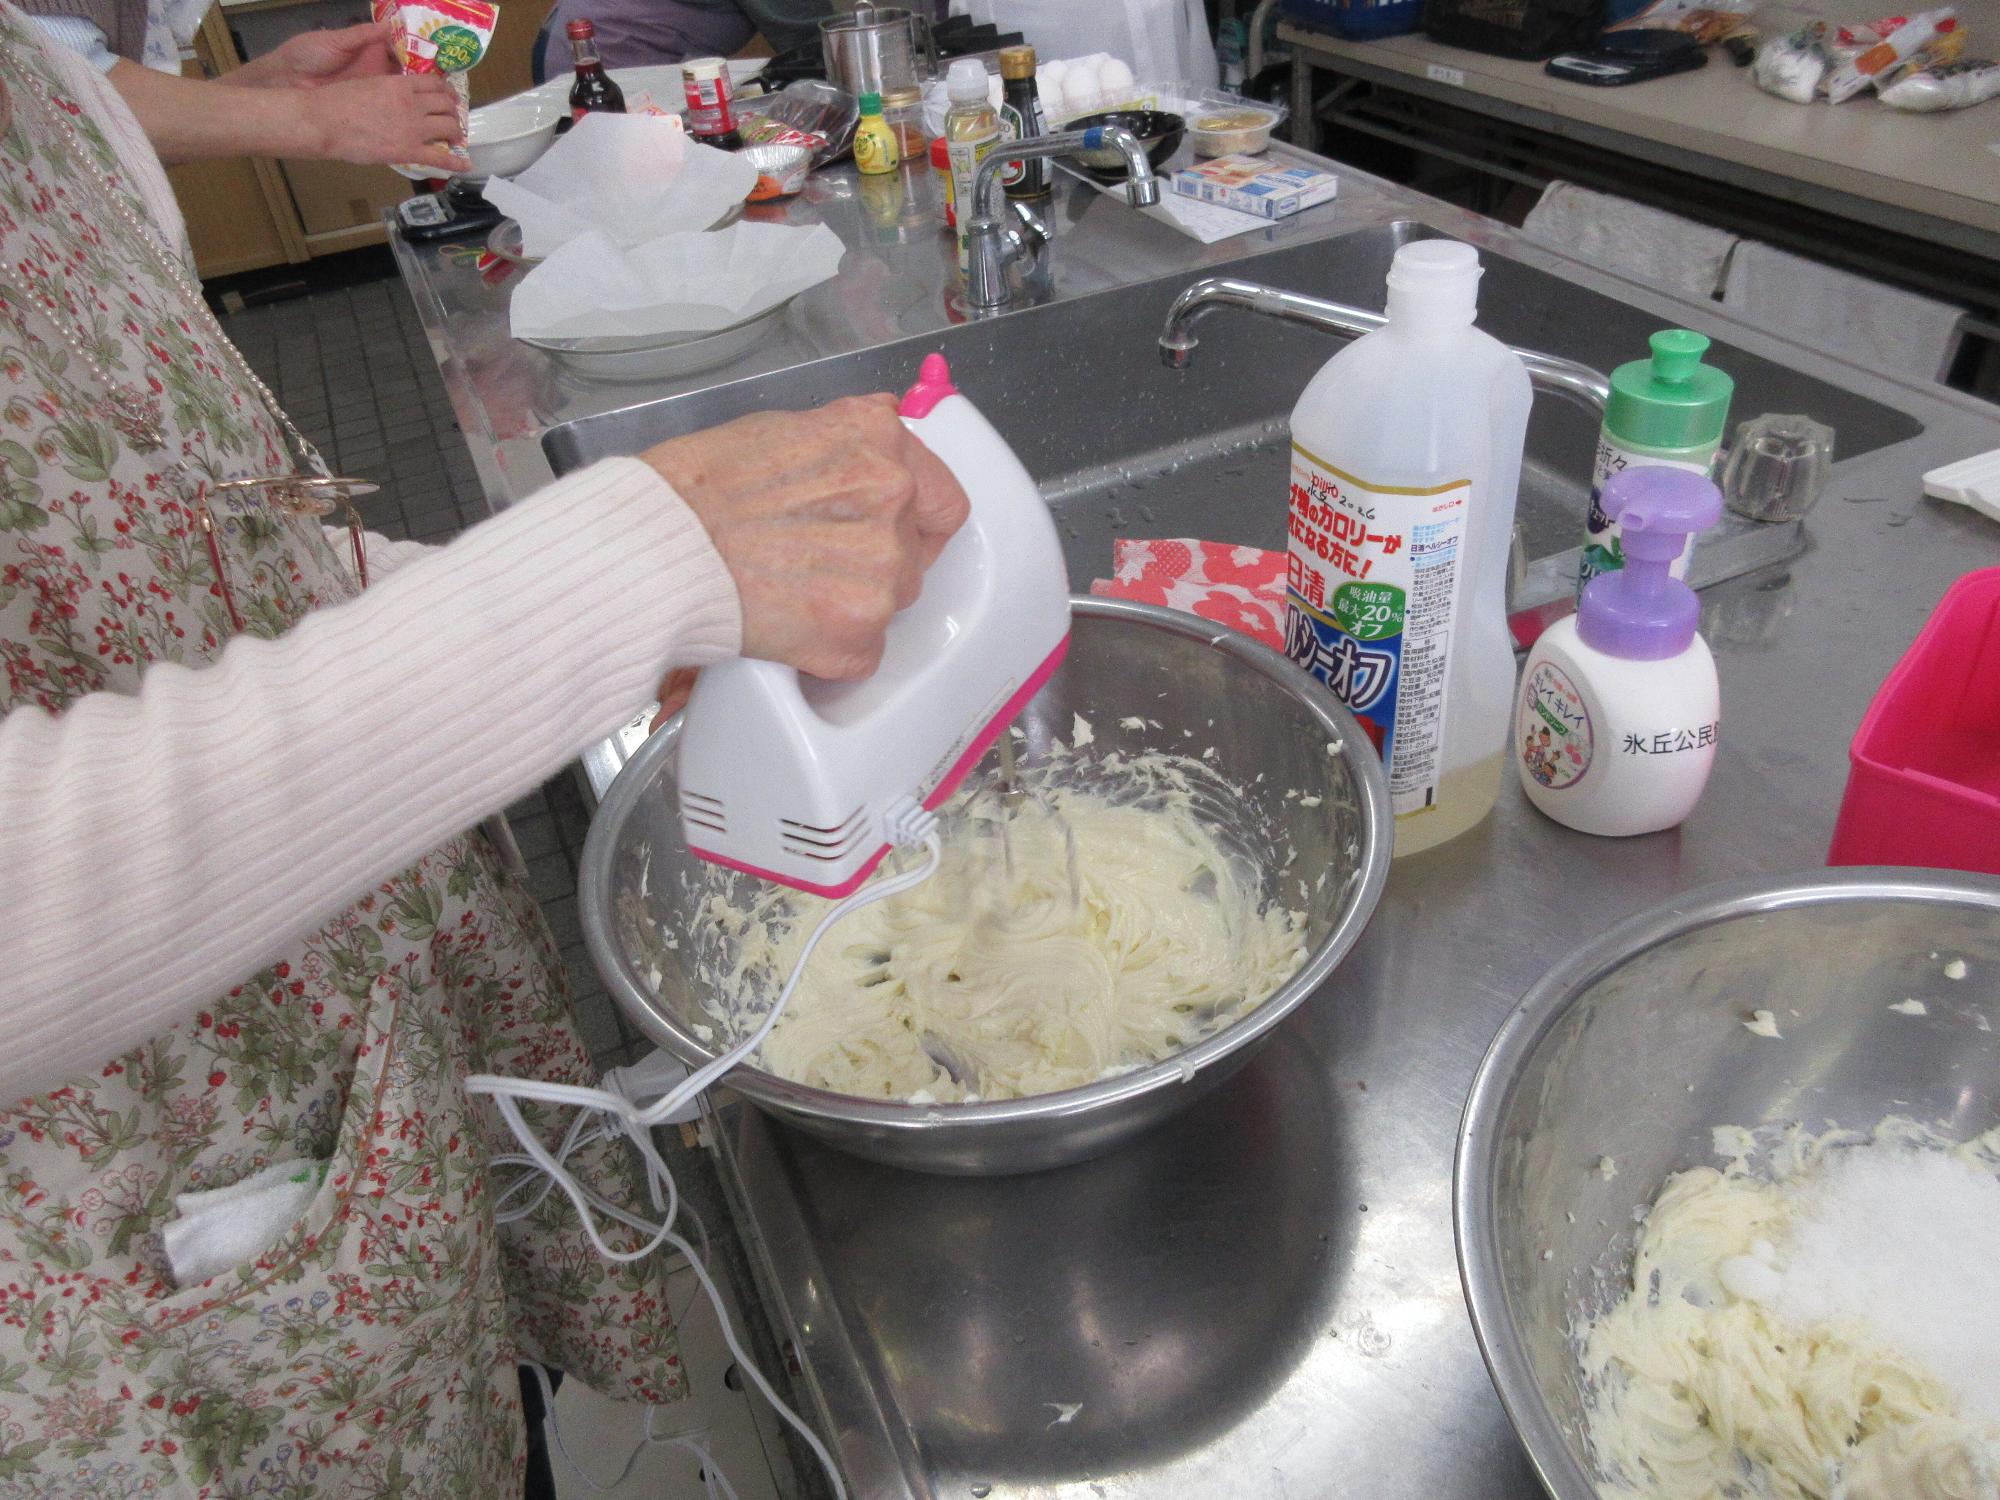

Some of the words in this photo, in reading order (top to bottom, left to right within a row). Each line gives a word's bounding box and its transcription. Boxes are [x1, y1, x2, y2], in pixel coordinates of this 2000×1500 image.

[1287, 550, 1325, 609] 日清
[1349, 586, 1393, 604] 吸油量
[1337, 597, 1403, 623] 最大20%
[1349, 620, 1384, 638] オフ
